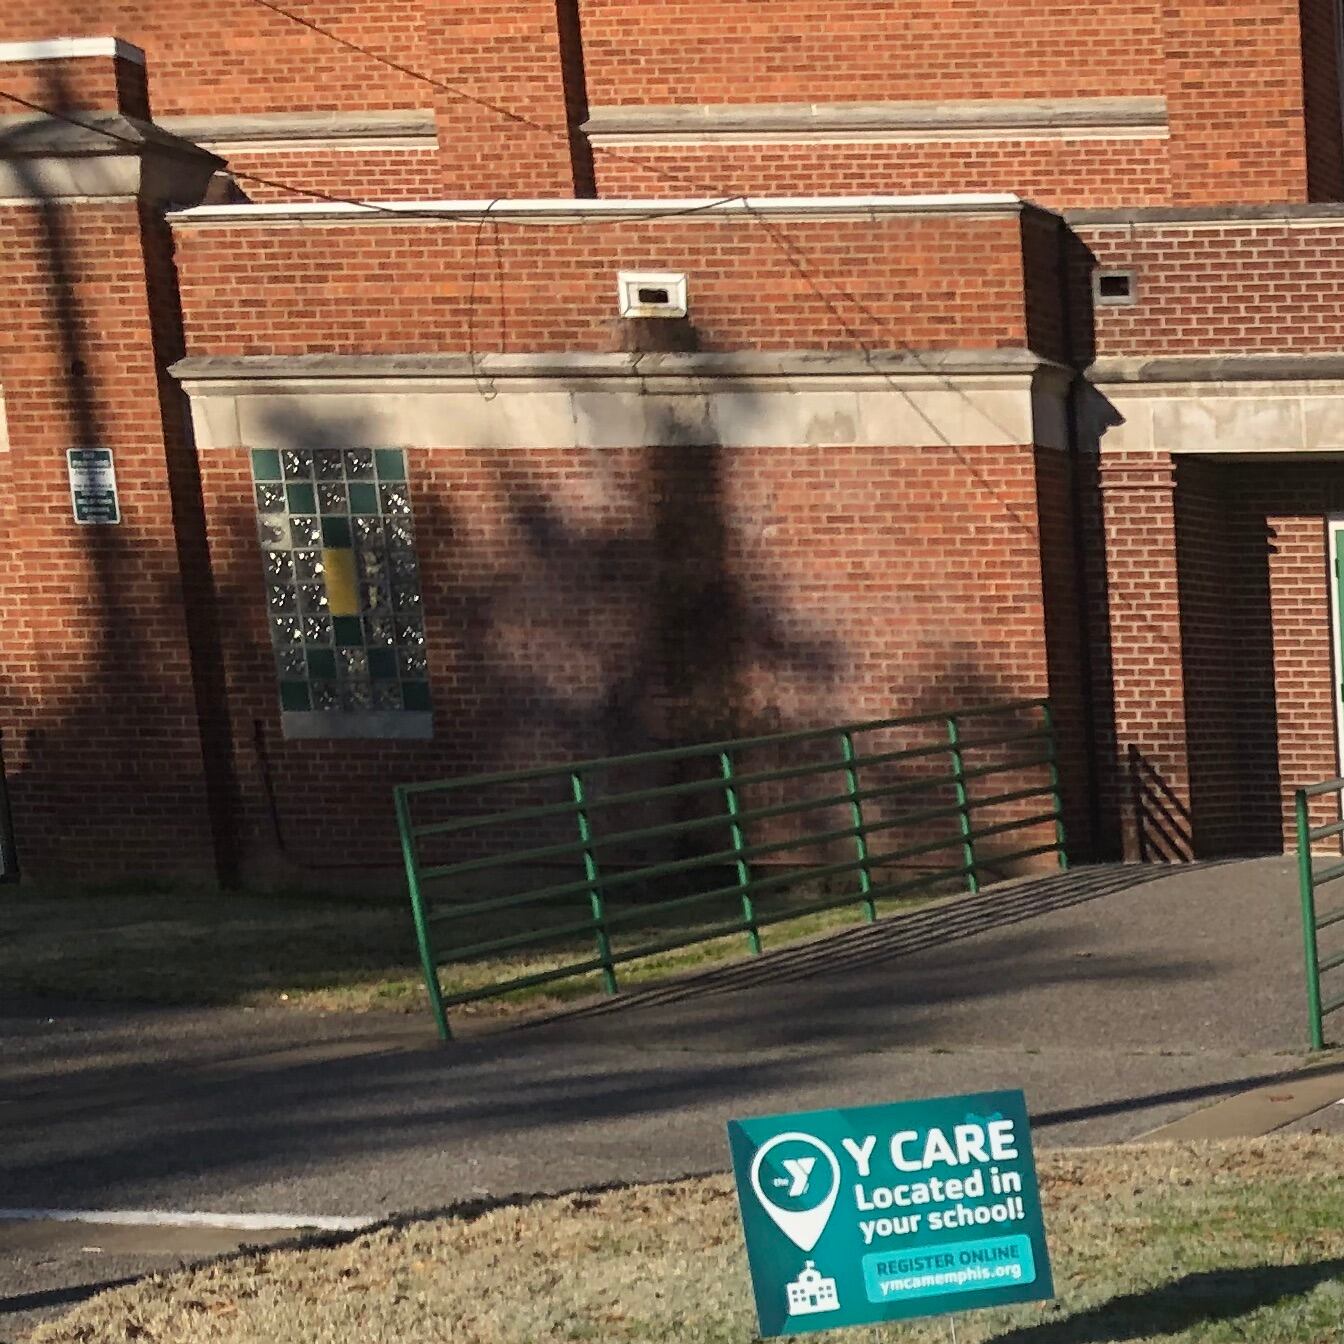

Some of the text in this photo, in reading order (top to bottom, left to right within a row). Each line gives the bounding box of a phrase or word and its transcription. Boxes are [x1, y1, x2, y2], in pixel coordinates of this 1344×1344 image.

[842, 1119, 1018, 1176] Y CARE
[854, 1166, 1022, 1211] Located in
[859, 1196, 1025, 1244] your school!
[877, 1245, 1020, 1275] REGISTER ONLINE
[880, 1264, 1022, 1296] ymcamemphis.org
